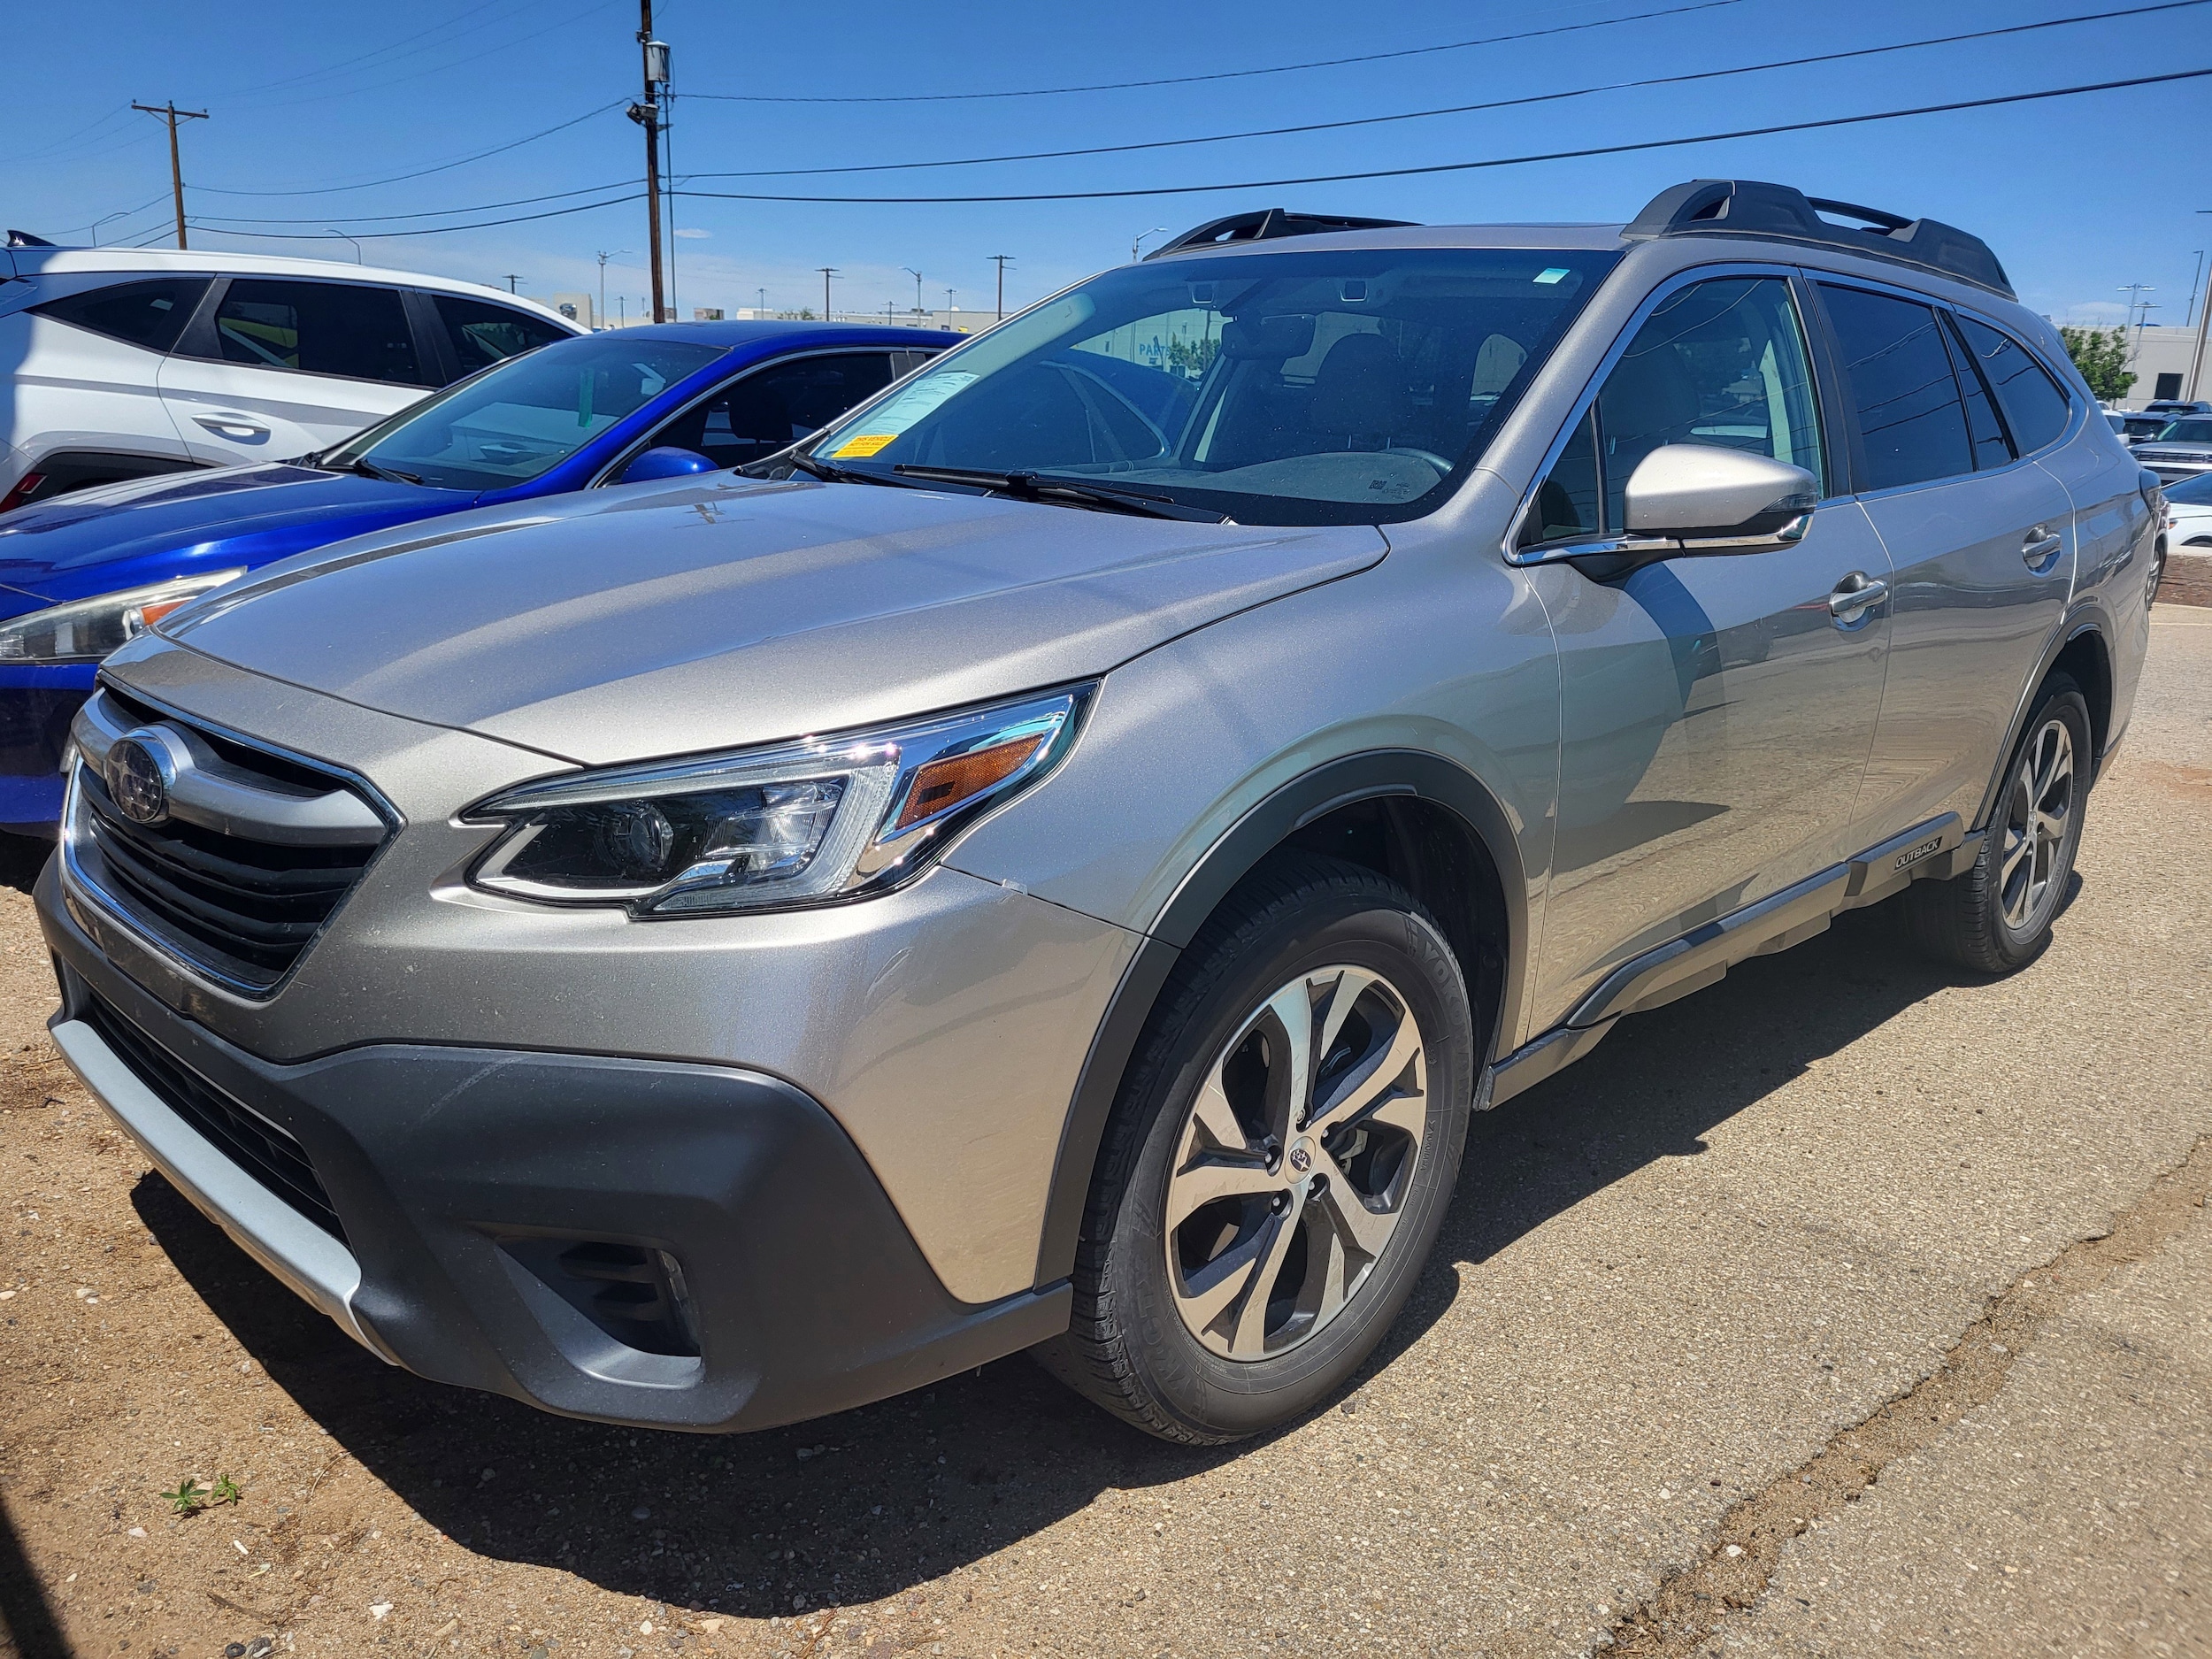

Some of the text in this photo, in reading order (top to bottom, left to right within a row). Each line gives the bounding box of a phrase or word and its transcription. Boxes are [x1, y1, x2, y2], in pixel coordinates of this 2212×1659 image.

[1139, 343, 1171, 356] PARTS
[1896, 838, 1939, 868] OUTBACK
[1422, 941, 1471, 1138] YOKOHAMA
[1420, 1129, 1434, 1171] YOKOHAMA
